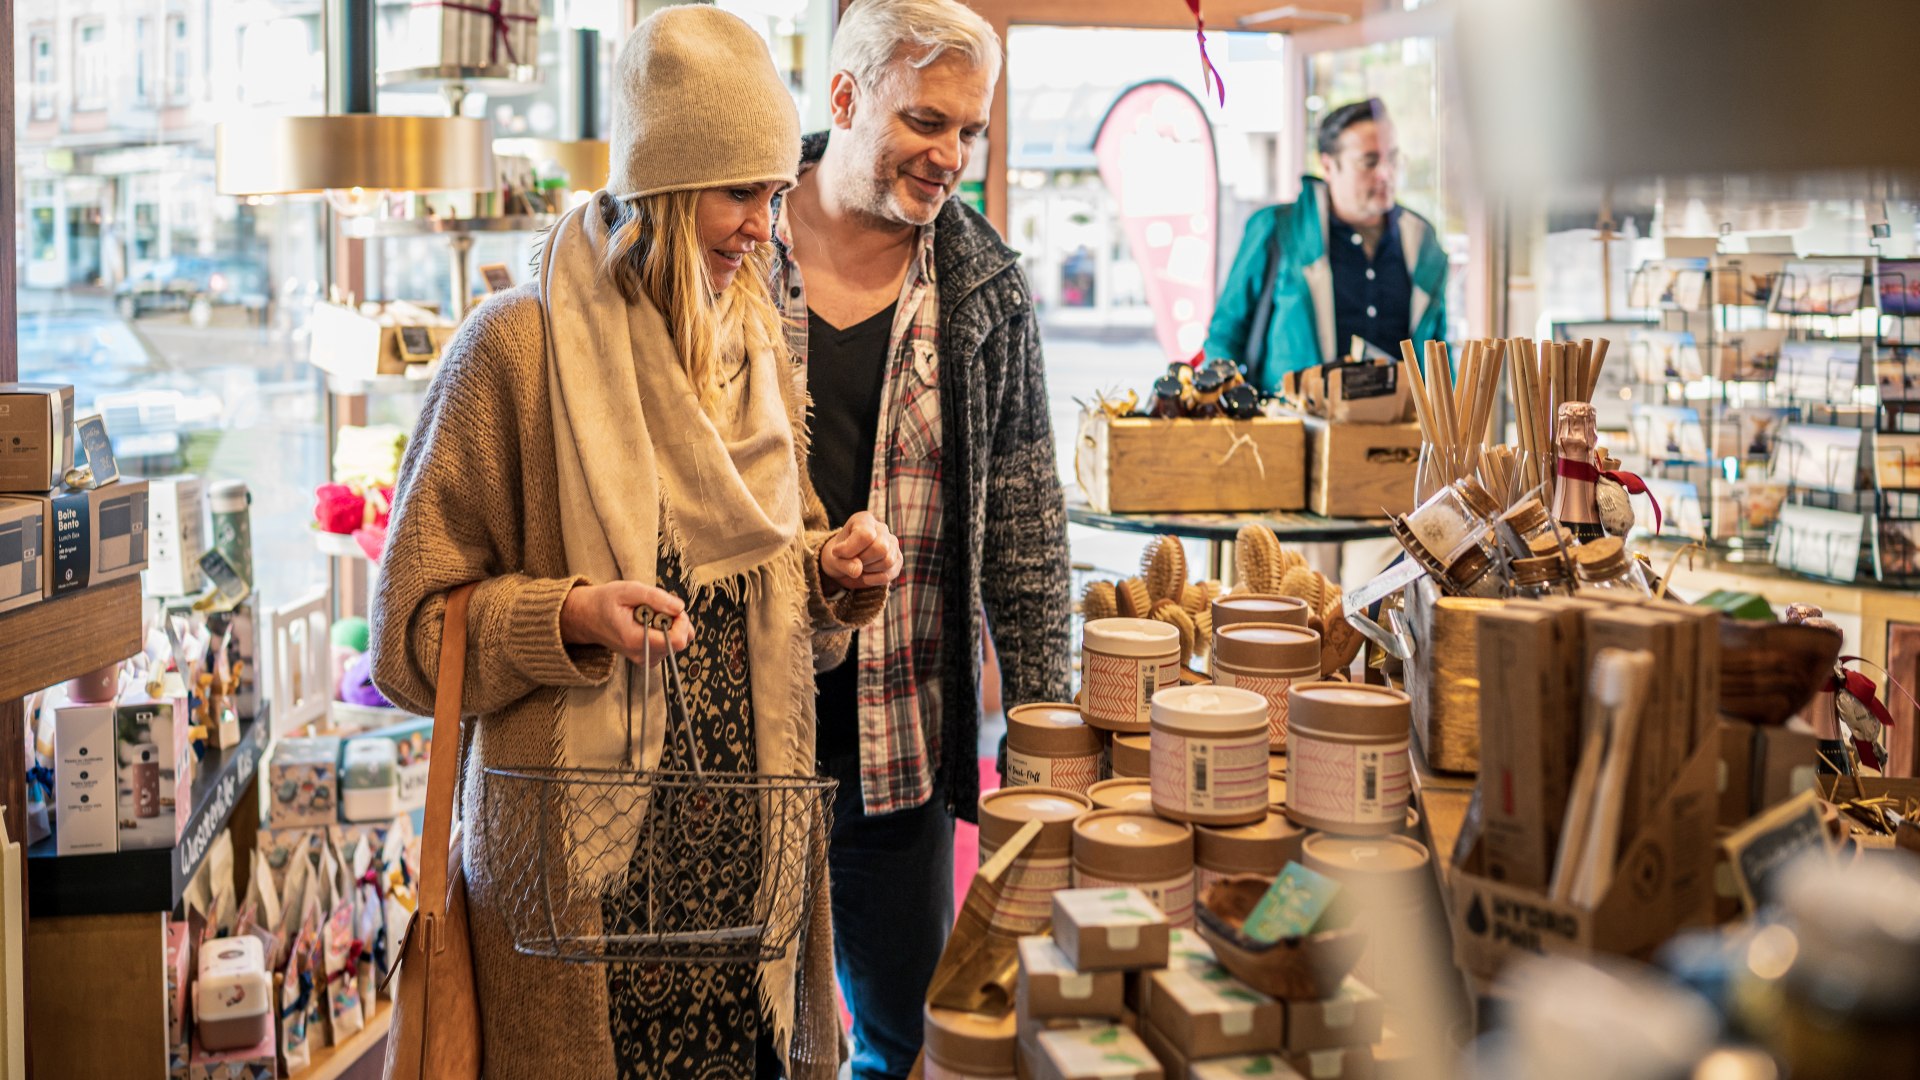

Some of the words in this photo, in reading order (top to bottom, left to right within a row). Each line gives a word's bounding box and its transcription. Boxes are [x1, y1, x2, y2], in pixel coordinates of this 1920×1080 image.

[58, 519, 80, 532] Bento
[58, 533, 71, 542] Lunch
[1492, 896, 1579, 941] HYDRO
